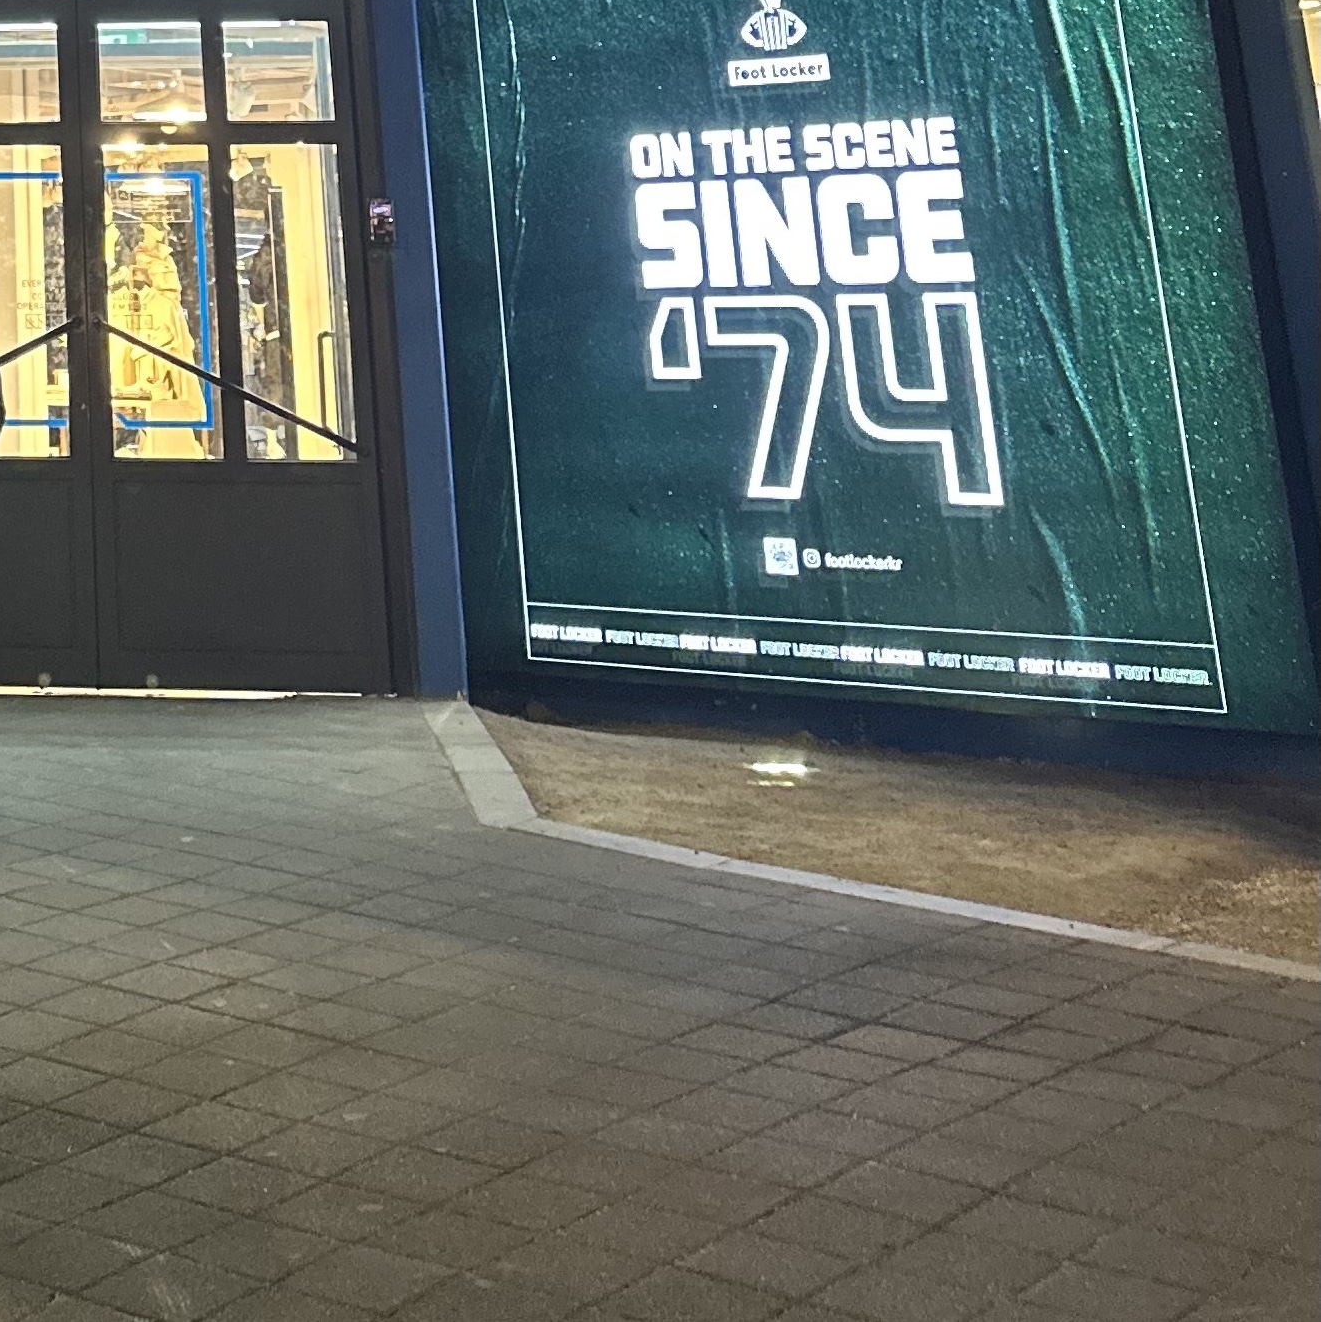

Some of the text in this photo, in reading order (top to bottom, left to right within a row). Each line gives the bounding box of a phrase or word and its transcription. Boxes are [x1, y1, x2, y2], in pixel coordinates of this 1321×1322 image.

[734, 62, 823, 80] Foot Locker
[630, 116, 960, 178] ON THE SCENE
[635, 169, 975, 289] SINCE
